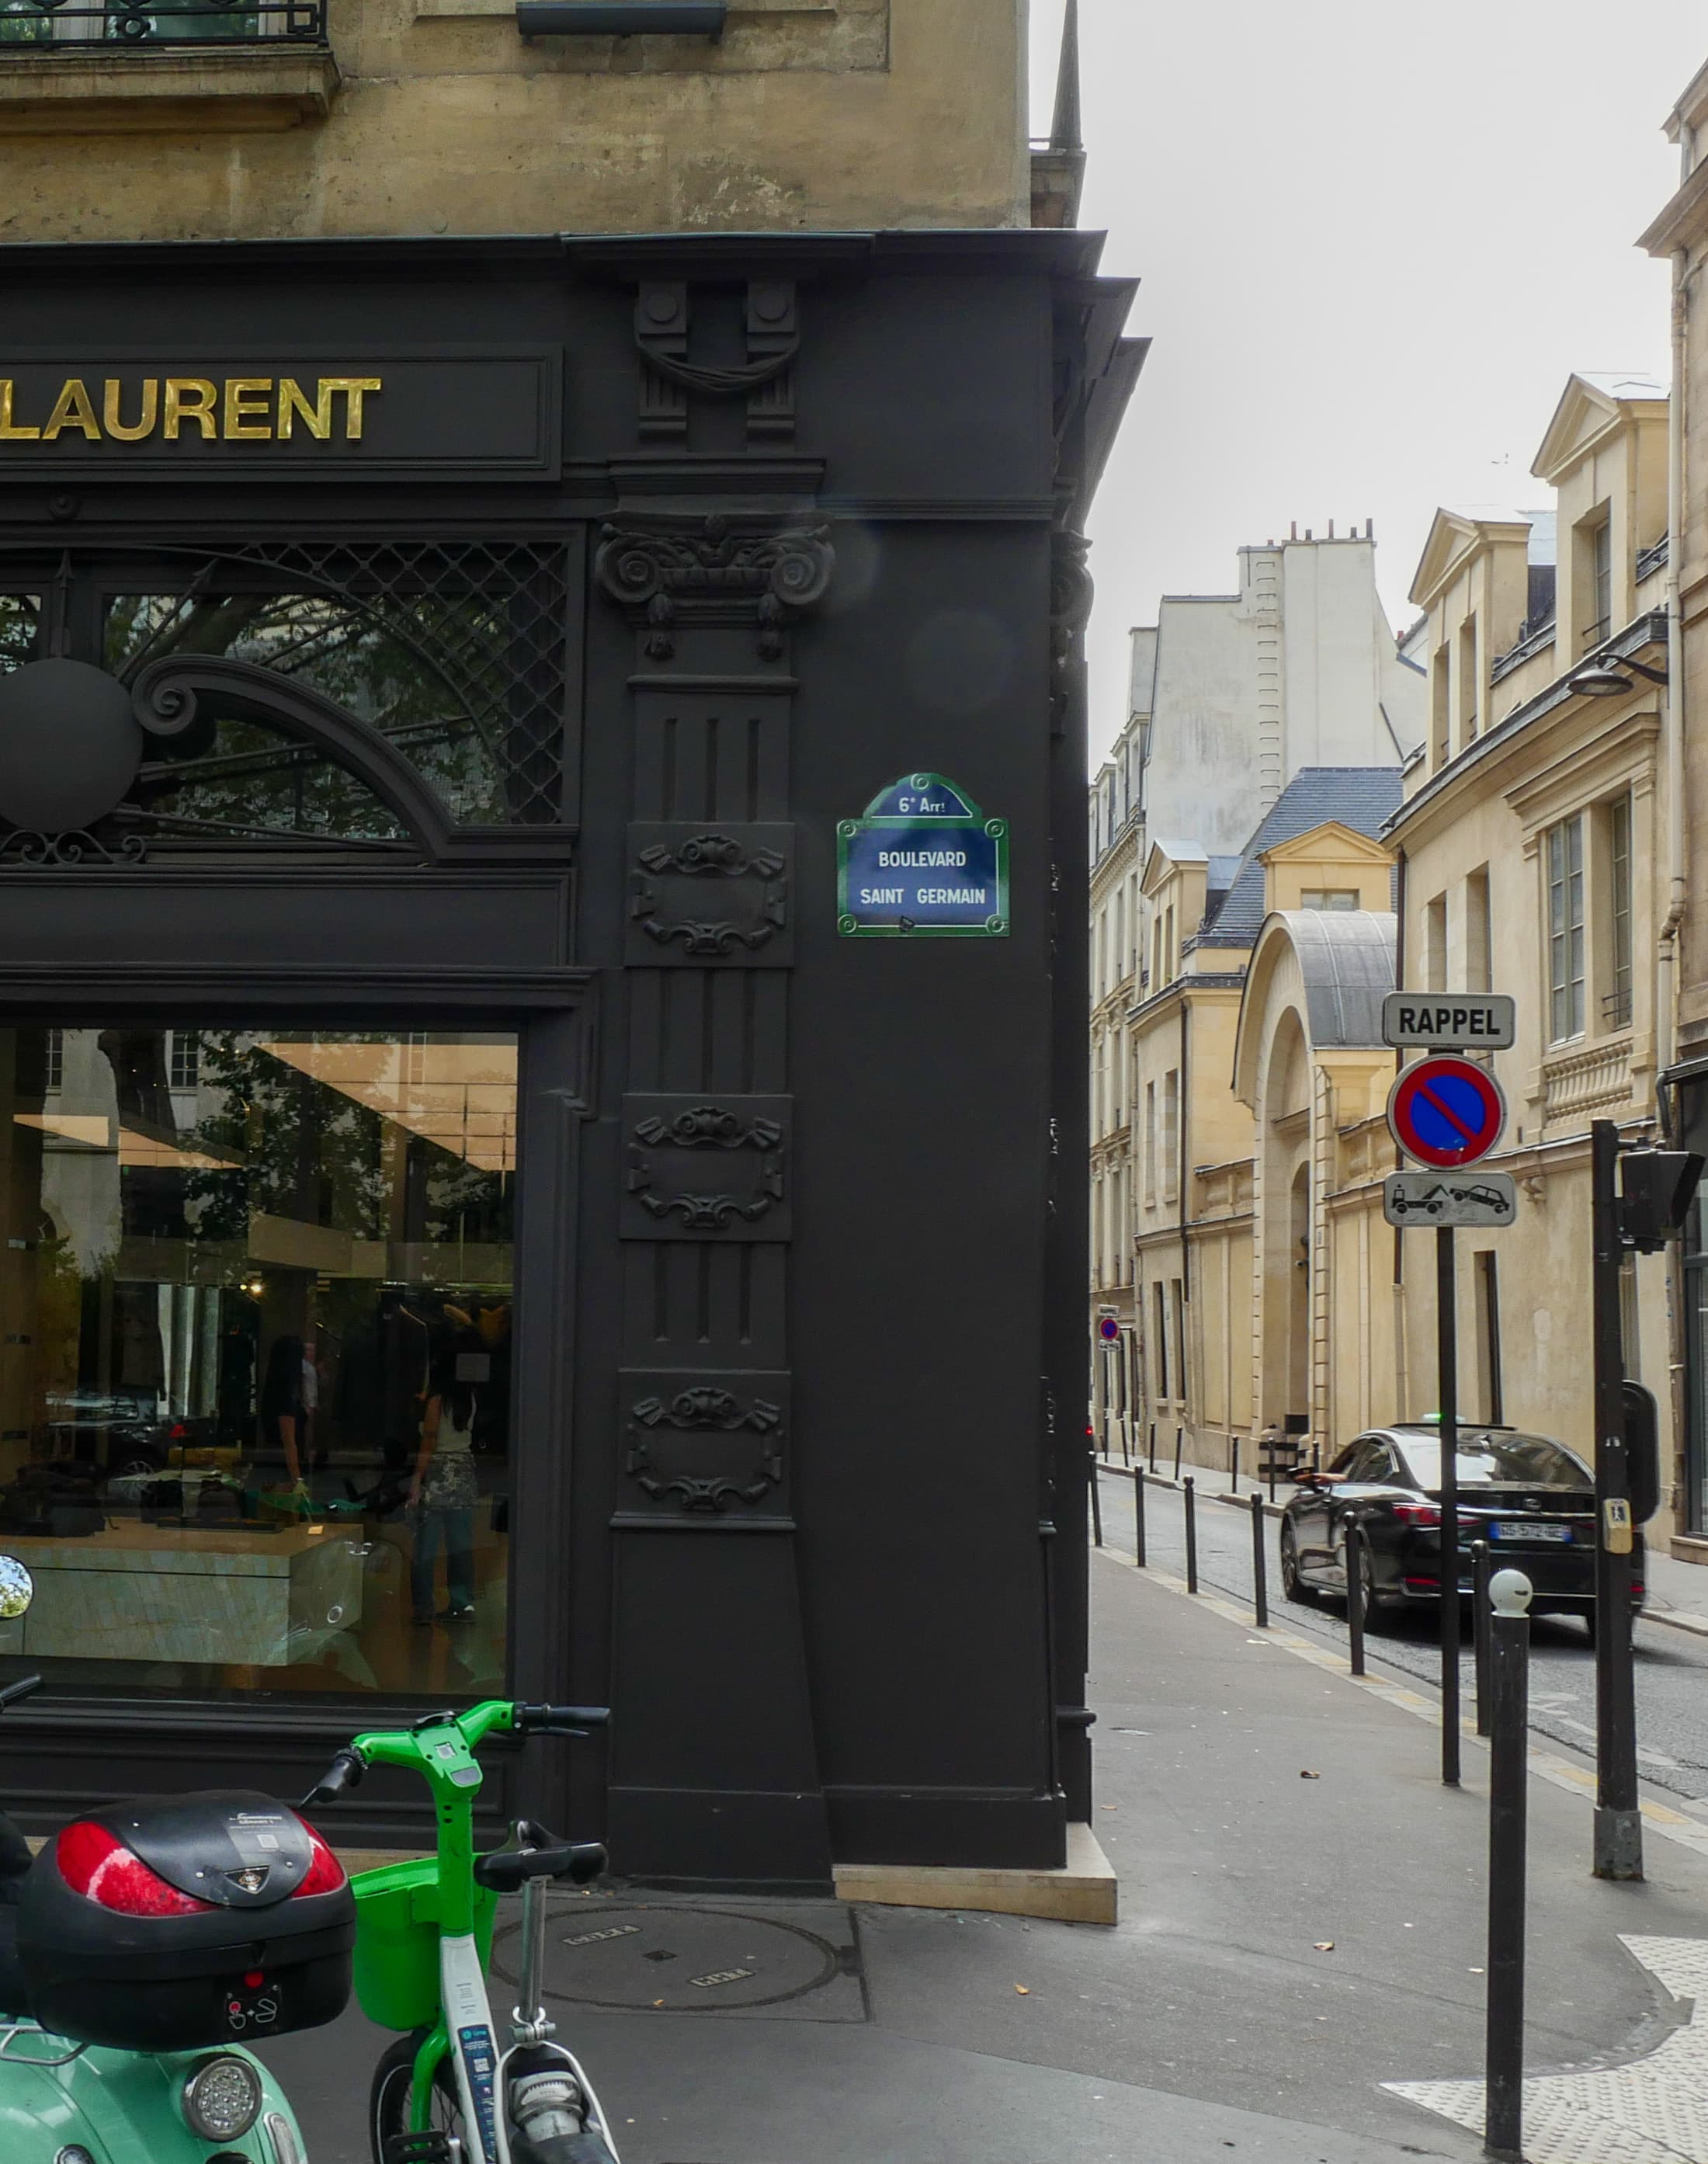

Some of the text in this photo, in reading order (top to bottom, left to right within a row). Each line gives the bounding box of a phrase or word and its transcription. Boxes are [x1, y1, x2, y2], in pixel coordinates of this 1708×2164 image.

[0, 378, 381, 440] LAURENT
[878, 852, 967, 867] BOULEVARD
[860, 888, 986, 905] SAINT GERMAIN
[1399, 1008, 1501, 1035] RAPPEL
